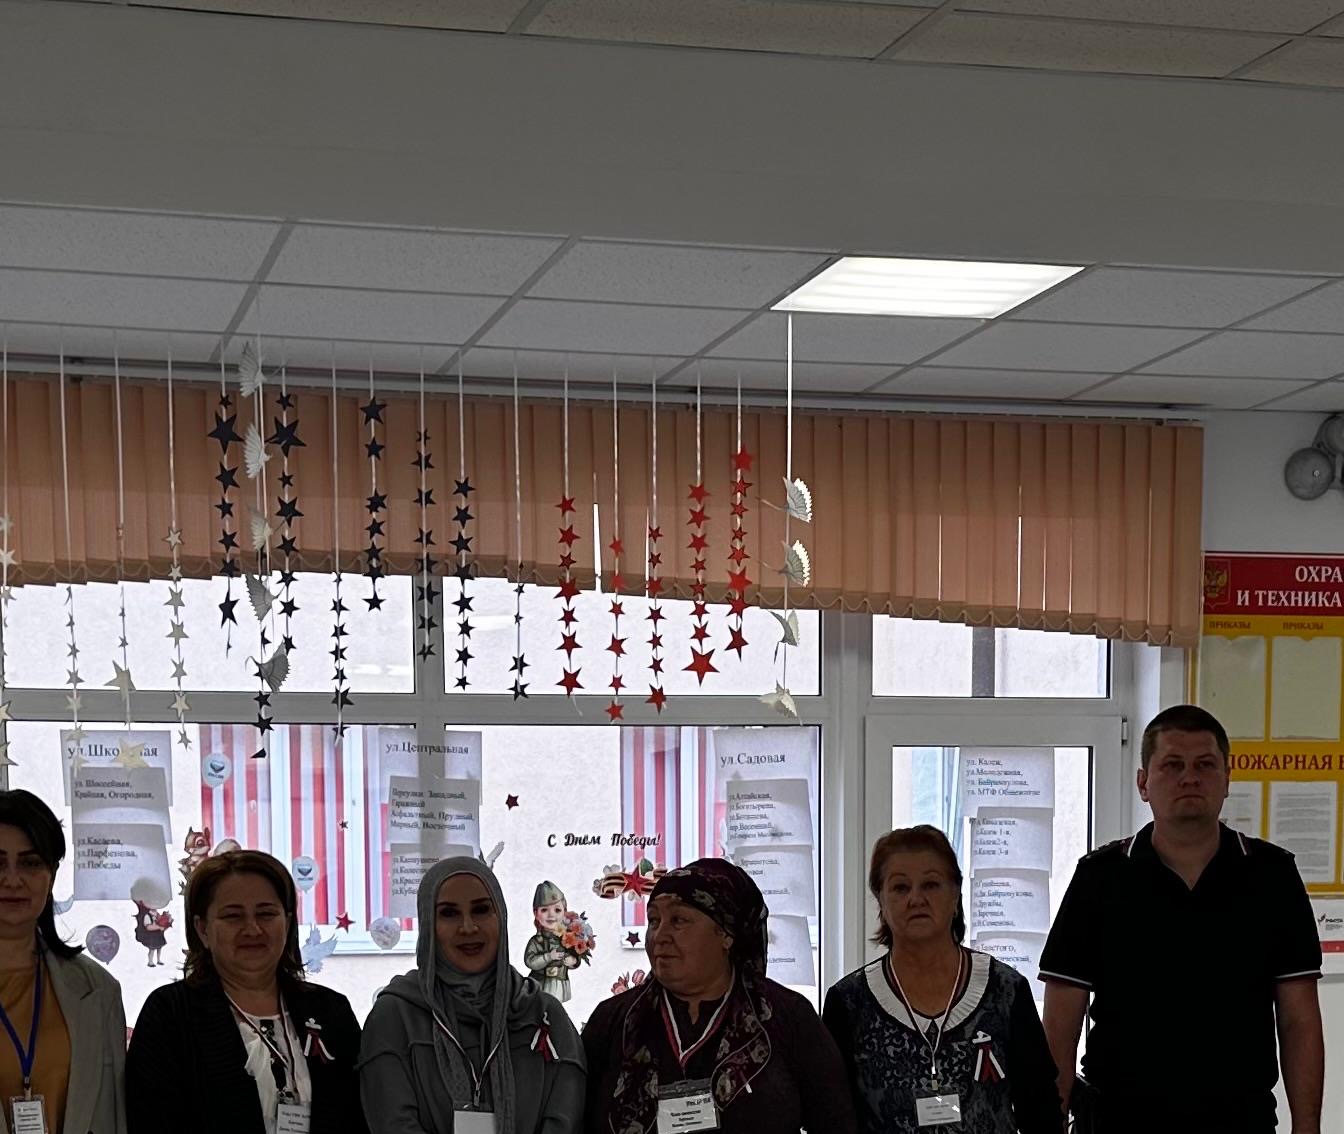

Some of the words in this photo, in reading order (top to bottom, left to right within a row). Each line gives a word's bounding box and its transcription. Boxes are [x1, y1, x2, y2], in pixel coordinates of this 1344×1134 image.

[1236, 590, 1250, 607] И
[1255, 590, 1342, 608] ТЕХНИКА
[720, 753, 786, 767] ул.Садовая
[610, 832, 661, 850] Победы!
